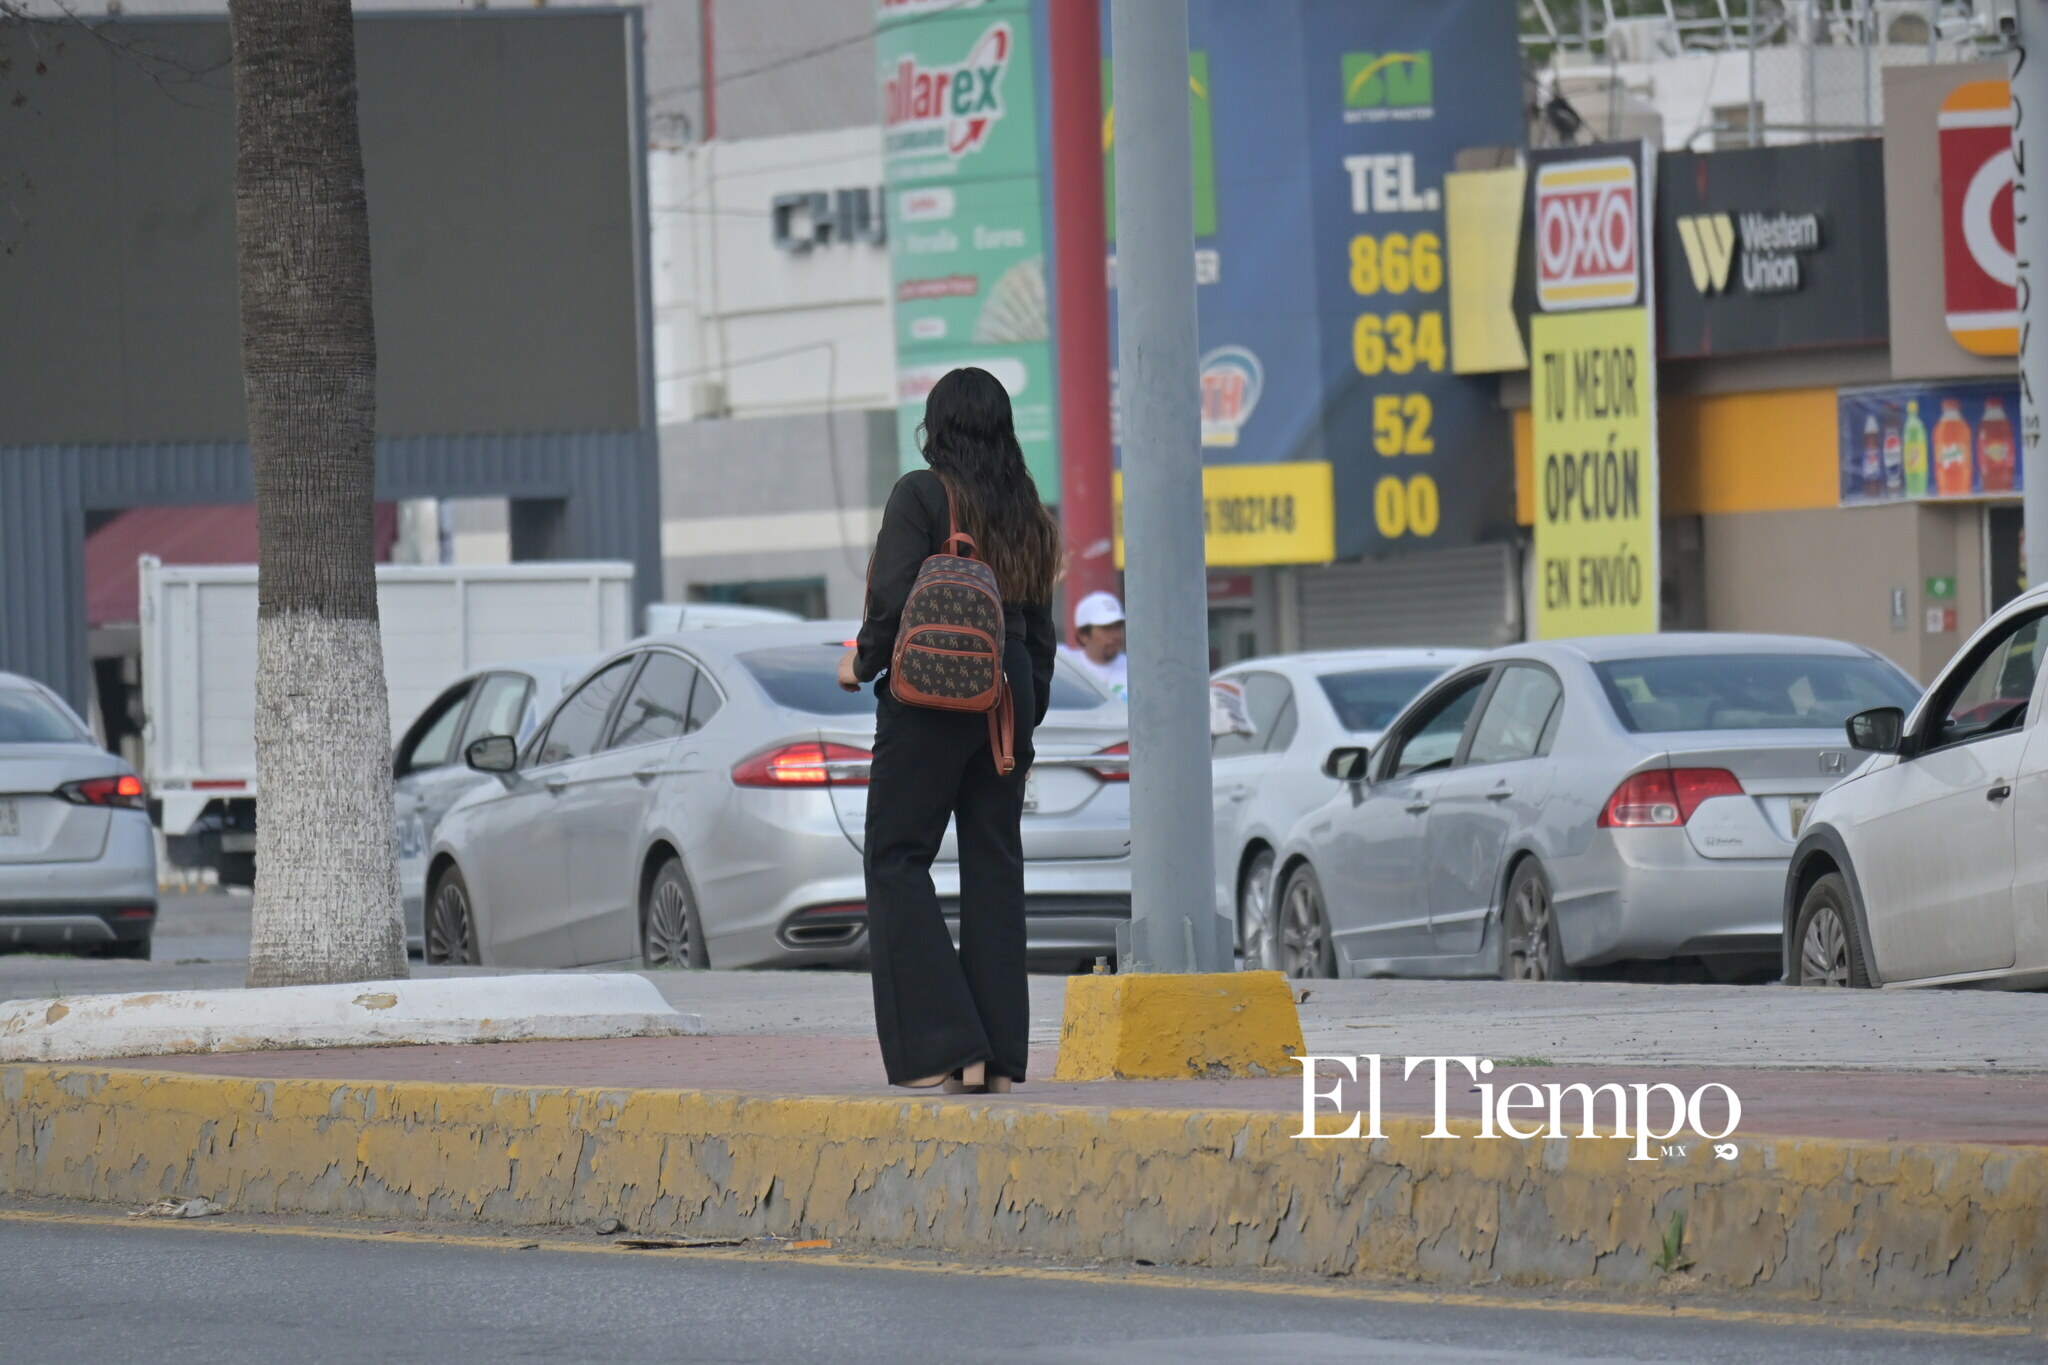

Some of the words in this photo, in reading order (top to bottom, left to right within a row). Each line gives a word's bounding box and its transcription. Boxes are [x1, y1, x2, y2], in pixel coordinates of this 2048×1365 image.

[1343, 153, 1441, 214] TEL.
[1349, 230, 1443, 295] 866
[1542, 184, 1632, 280] OXXO
[1740, 211, 1818, 250] Western
[1742, 250, 1799, 290] Union
[1353, 311, 1446, 376] 634
[1544, 352, 1568, 422] TU
[1574, 346, 1639, 420] MEJOR
[1373, 393, 1434, 456] 52
[1374, 474, 1440, 539] 00
[1545, 431, 1640, 524] OPCIÓN
[1547, 557, 1572, 610] EN
[1579, 542, 1642, 608] ENVÍO
